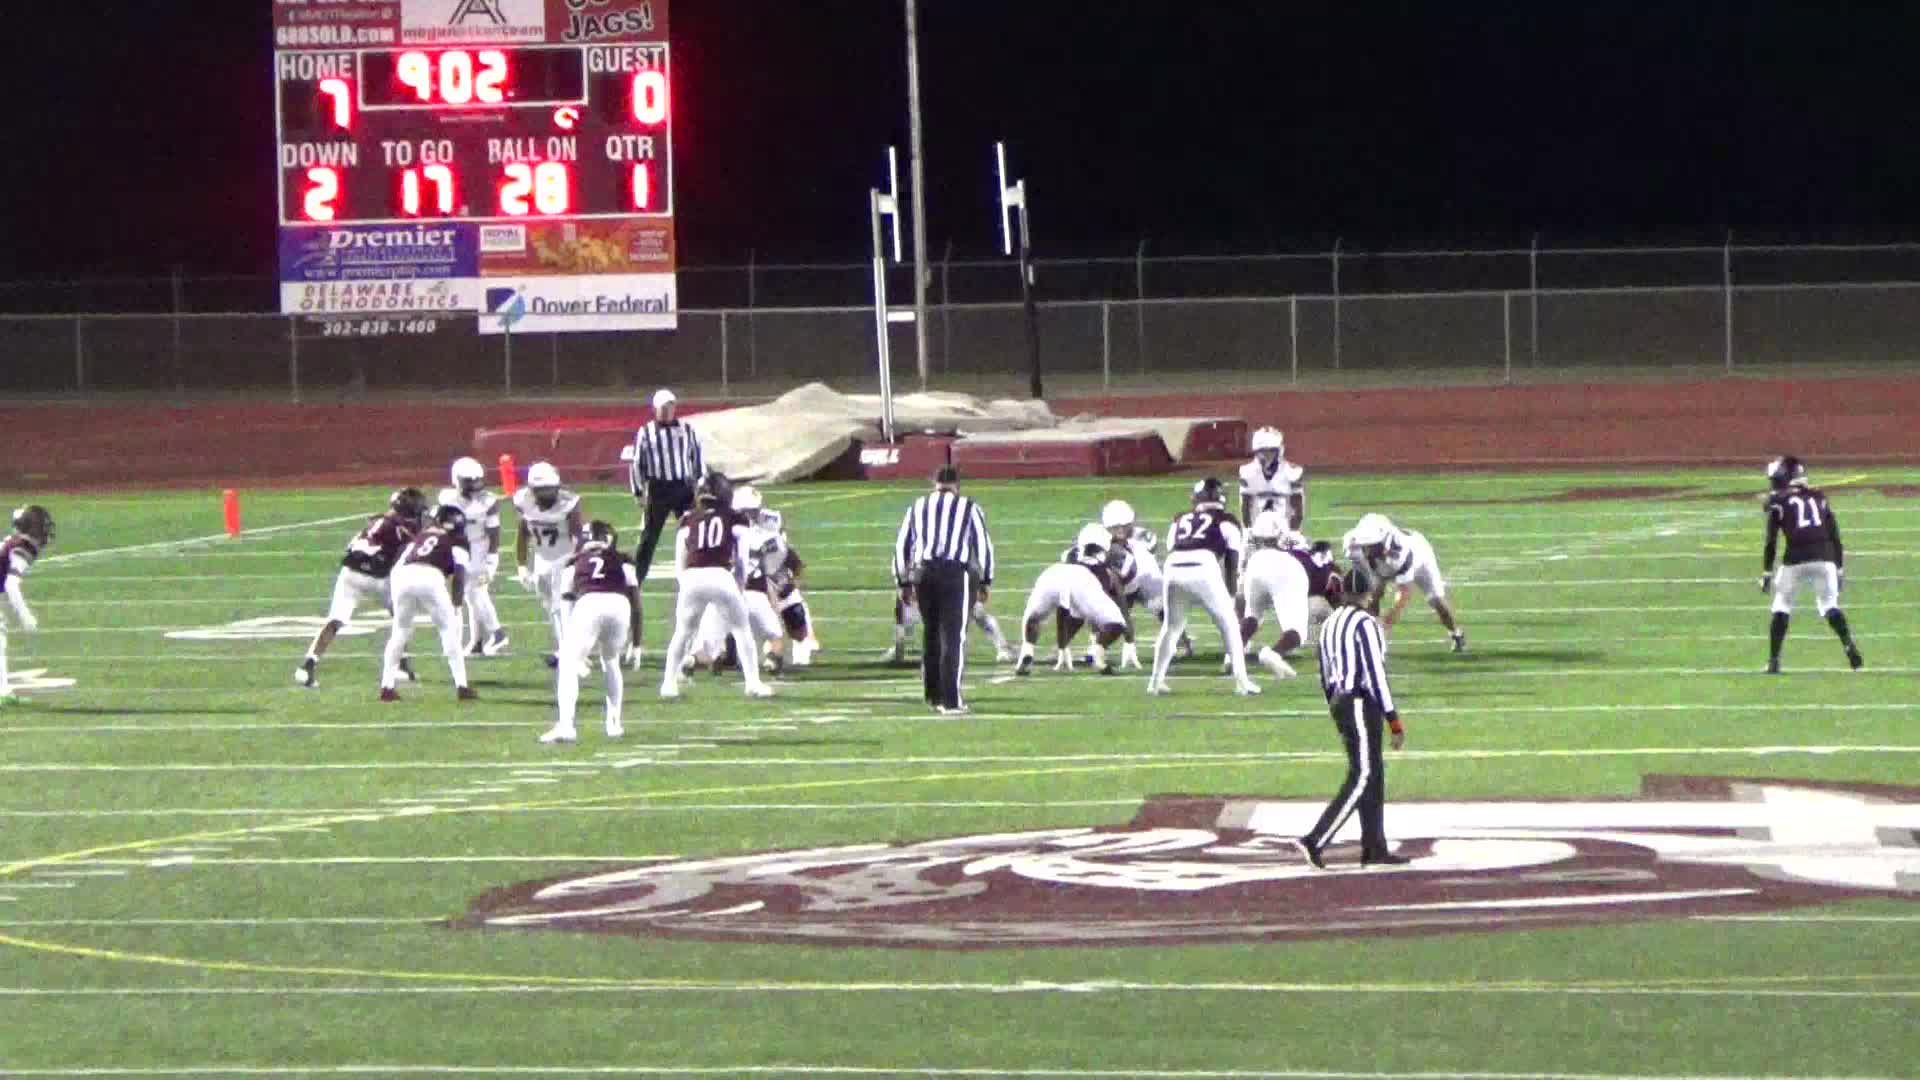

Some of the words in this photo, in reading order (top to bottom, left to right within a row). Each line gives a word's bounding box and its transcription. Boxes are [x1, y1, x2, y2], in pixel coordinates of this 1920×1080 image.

[563, 2, 653, 40] JAGS!
[280, 54, 352, 80] HOME
[588, 47, 663, 73] GUEST
[320, 79, 350, 128] 7
[633, 71, 666, 124] 0
[282, 142, 358, 168] DOWN
[381, 140, 412, 166] TO
[420, 139, 454, 164] GO
[487, 137, 542, 164] BALL
[547, 135, 577, 162] ON
[605, 135, 654, 161] QTR
[304, 166, 338, 220] 2
[402, 164, 452, 215] 17
[500, 161, 569, 216] 28
[633, 162, 648, 209] 1
[328, 225, 457, 250] Premier
[300, 294, 460, 310] ORTHODONTICS
[304, 283, 415, 298] DELAWARE
[531, 296, 592, 314] Dover
[595, 292, 669, 314] Federal
[1177, 512, 1212, 539] 52
[1788, 496, 1822, 528] 21
[698, 516, 723, 549] 10
[588, 556, 606, 579] 2
